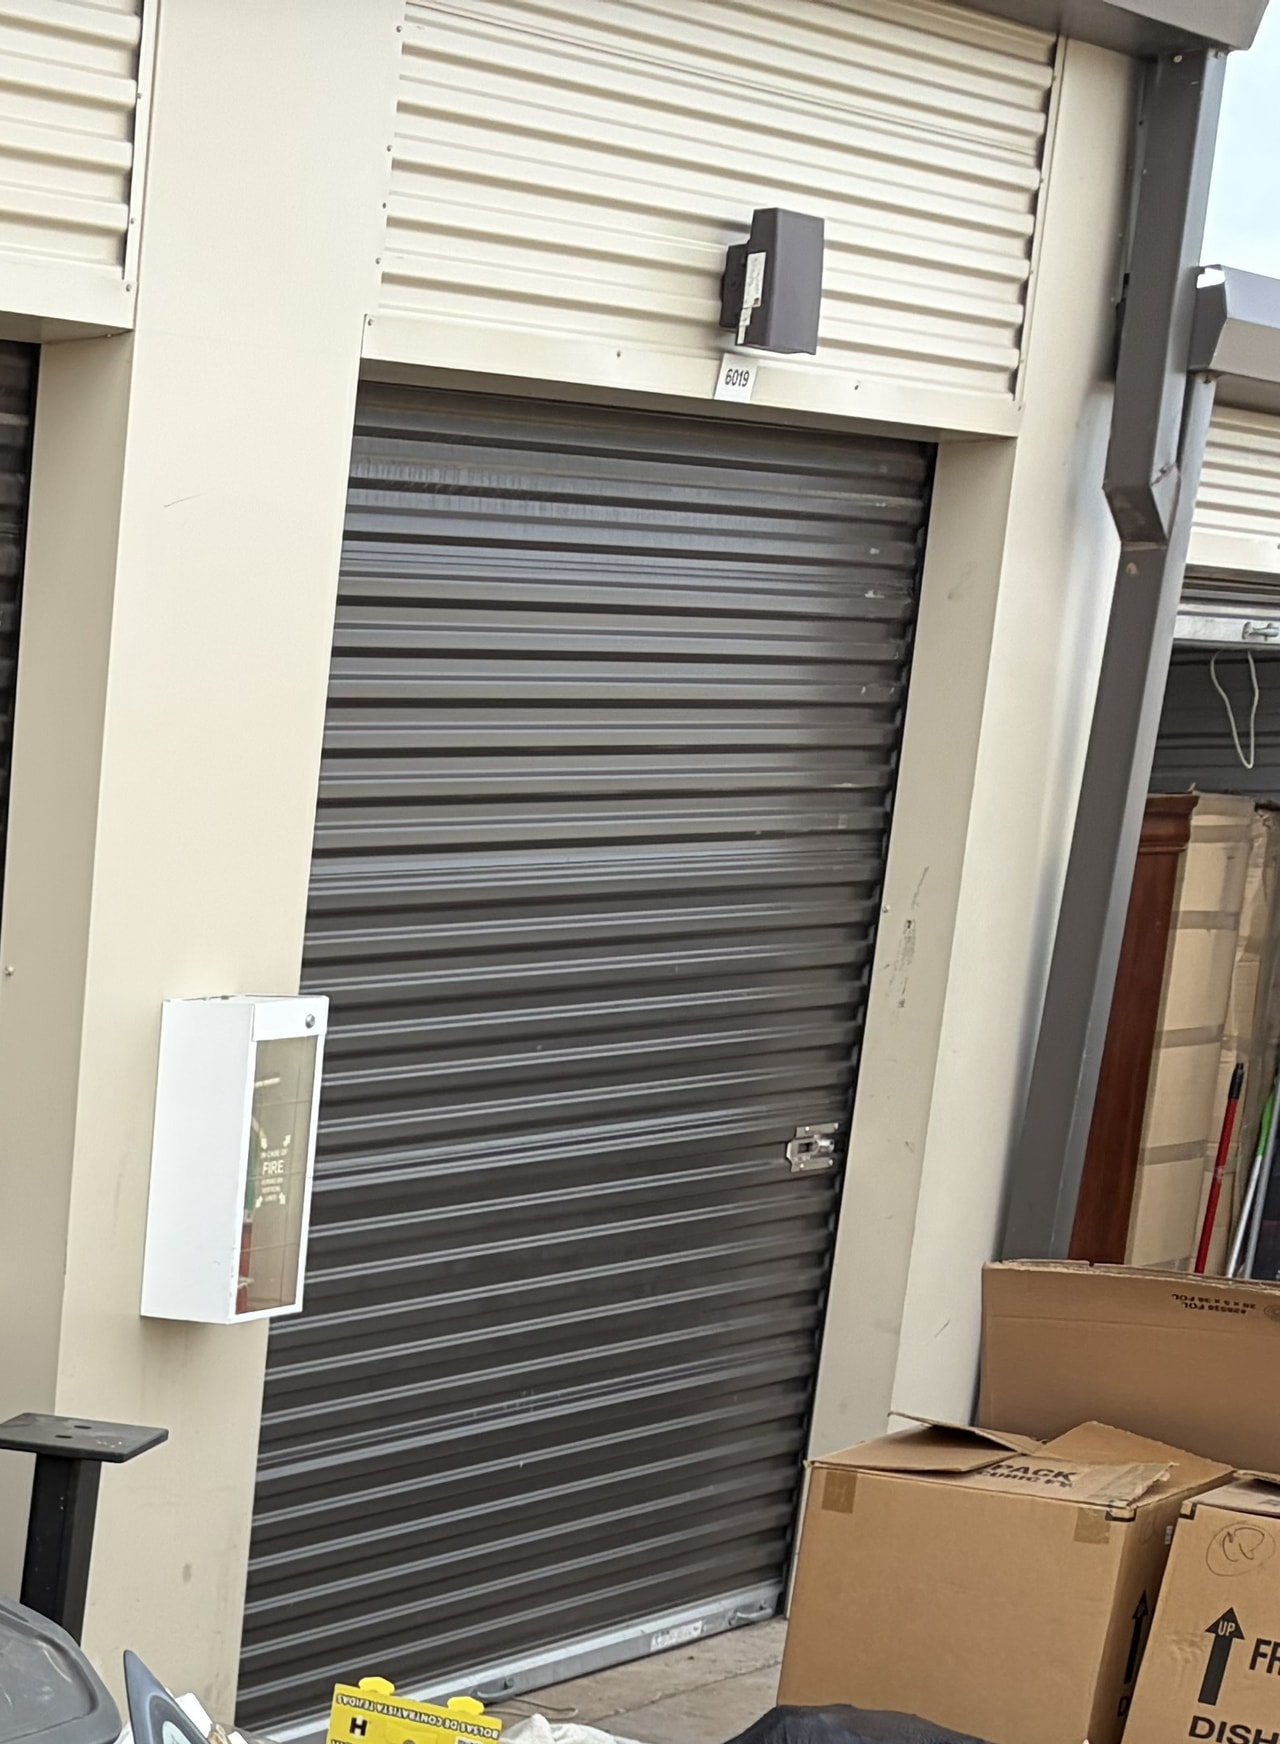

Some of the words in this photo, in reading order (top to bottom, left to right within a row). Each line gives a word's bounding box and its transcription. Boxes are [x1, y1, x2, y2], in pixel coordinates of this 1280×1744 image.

[724, 368, 750, 388] 6019
[262, 1160, 285, 1175] FIRE
[990, 1463, 1079, 1483] PACK
[1217, 1619, 1237, 1638] UP
[459, 1722, 500, 1740] BOLSAS
